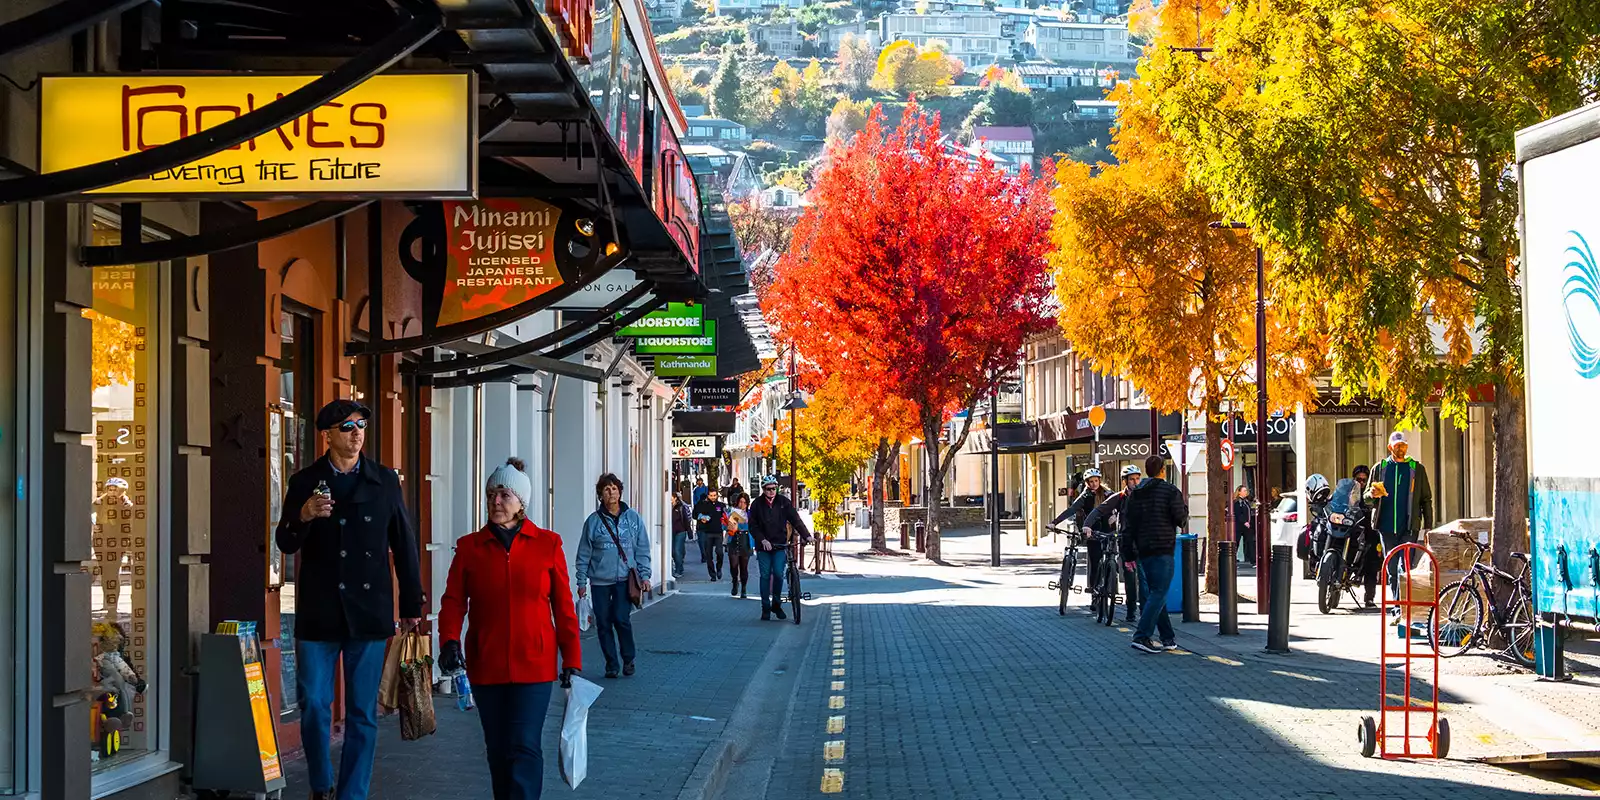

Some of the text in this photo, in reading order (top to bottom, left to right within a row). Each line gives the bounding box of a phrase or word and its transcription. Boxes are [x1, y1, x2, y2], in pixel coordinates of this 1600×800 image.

[453, 204, 551, 228] Minami
[460, 230, 545, 254] Jujisei
[468, 256, 541, 266] LICENSED
[466, 266, 544, 276] JAPANESE
[456, 276, 554, 287] RESTAURANT
[629, 317, 700, 328] QUORSTORE
[637, 337, 713, 346] LIQUORSTORE
[660, 360, 711, 369] Kathmandu
[1098, 443, 1168, 456] GLASSOS
